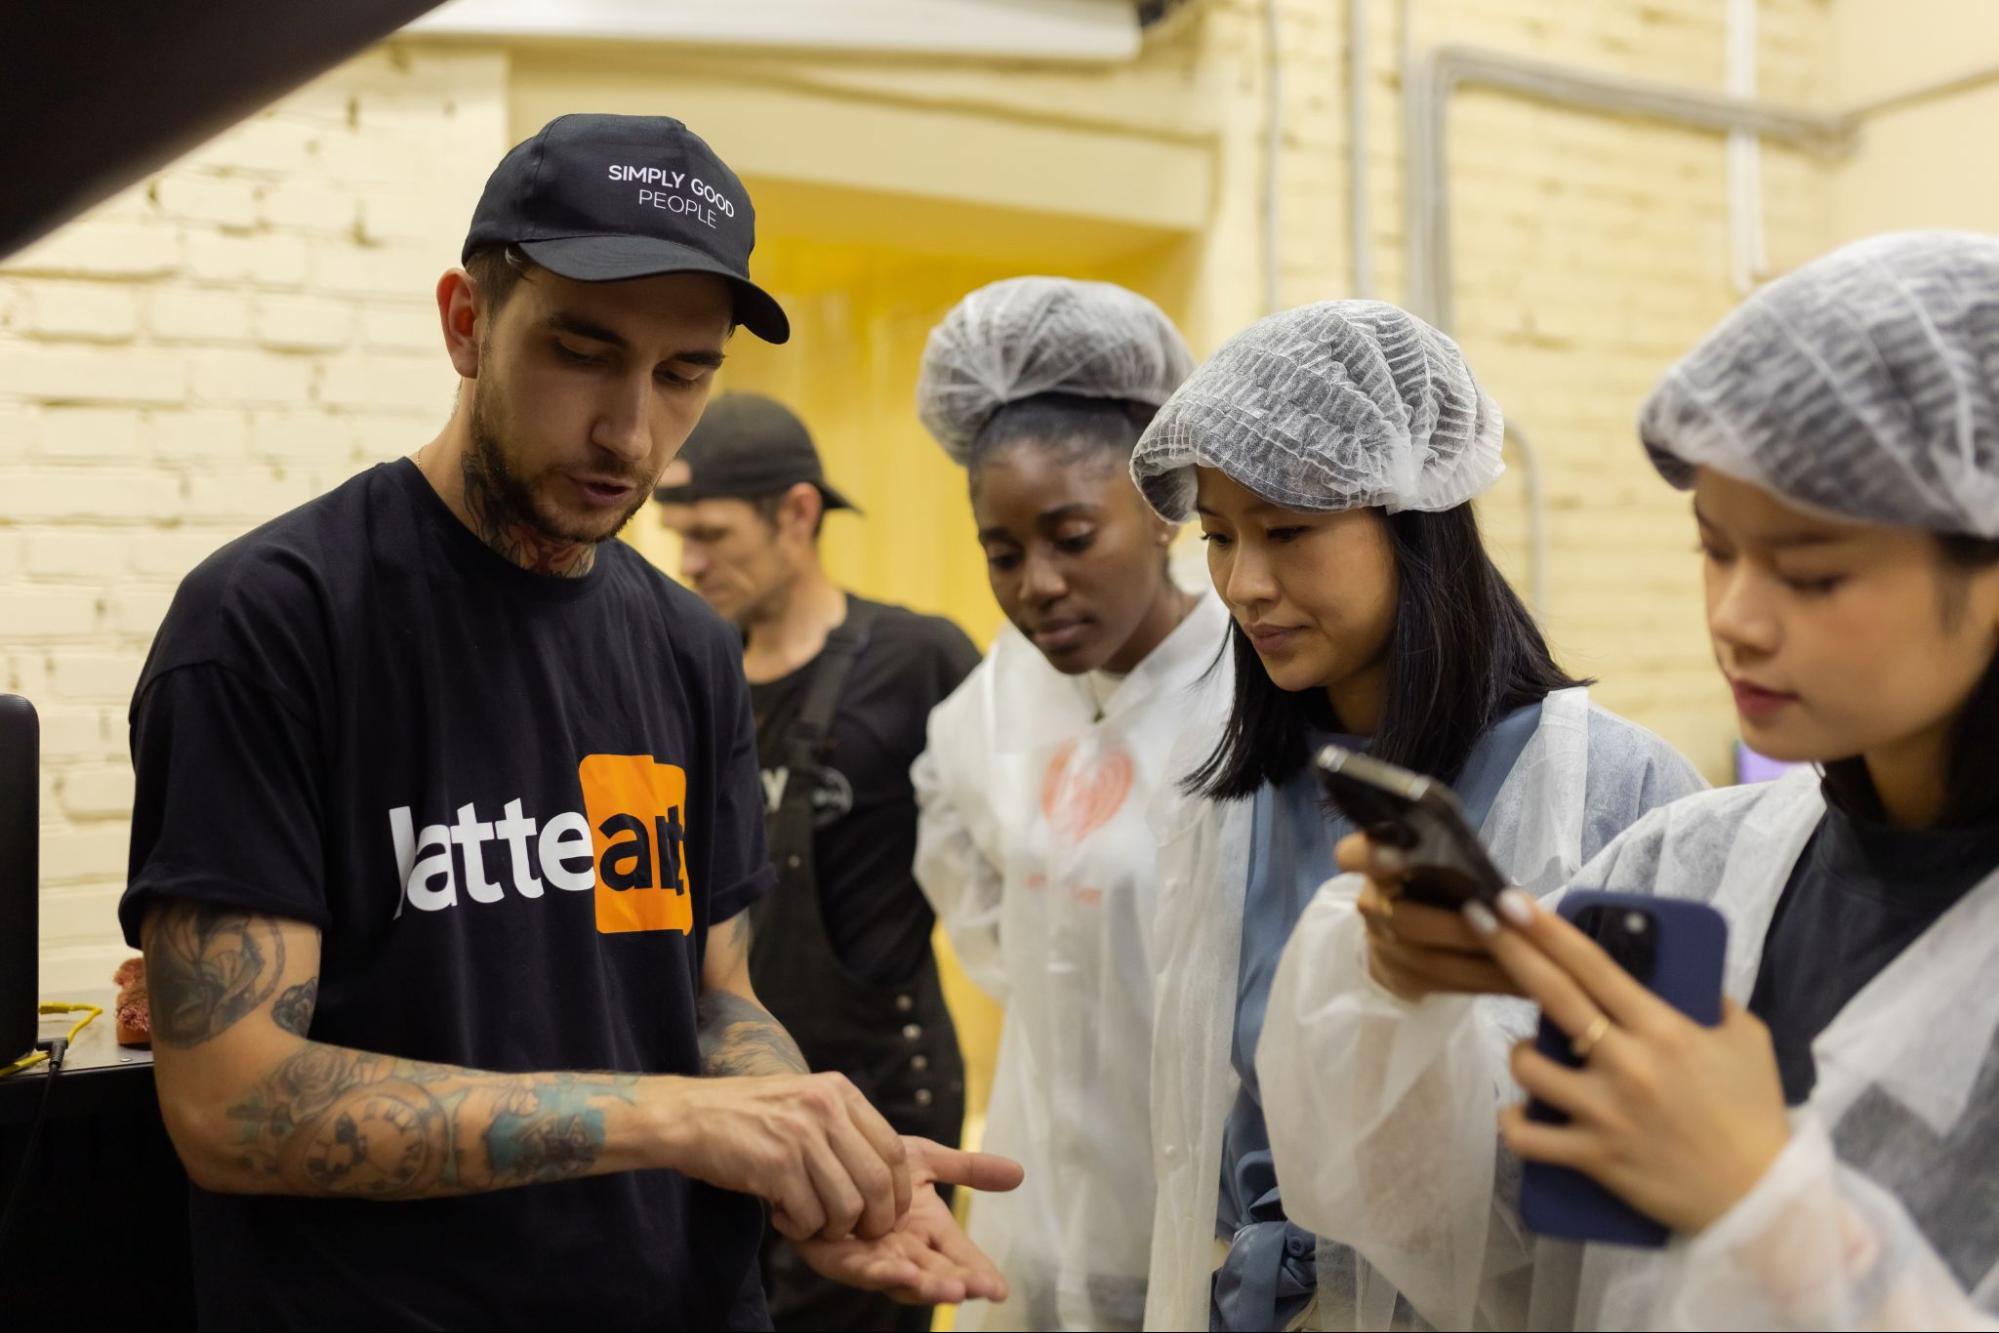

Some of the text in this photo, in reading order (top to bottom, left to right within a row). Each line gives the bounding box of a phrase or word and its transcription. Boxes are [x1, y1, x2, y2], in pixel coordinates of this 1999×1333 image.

[608, 164, 735, 218] SIMPLY GOOD
[638, 189, 717, 230] PEOPLE
